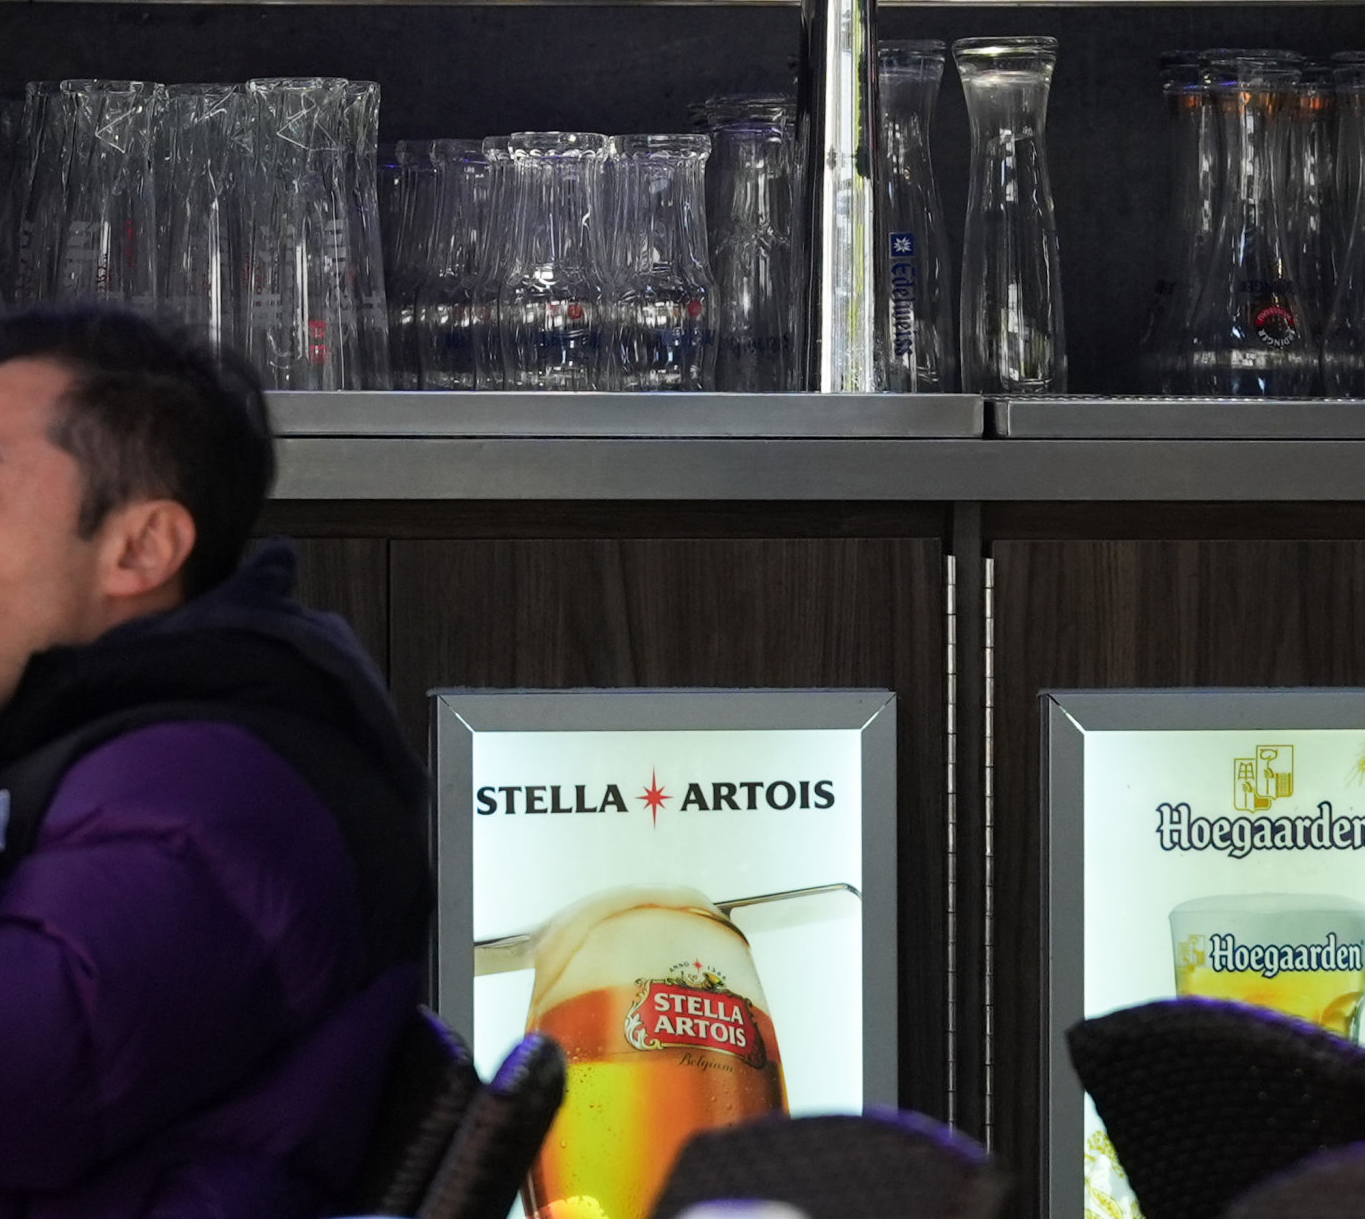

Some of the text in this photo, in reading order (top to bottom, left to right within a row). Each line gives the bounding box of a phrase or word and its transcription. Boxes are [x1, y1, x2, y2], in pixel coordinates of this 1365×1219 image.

[476, 779, 836, 816] STELLA ARTOIS
[669, 961, 690, 973] ANNO
[1209, 932, 1364, 979] Hoegaarden
[653, 991, 744, 1026] STELLA
[653, 1014, 747, 1048] ARTOIS
